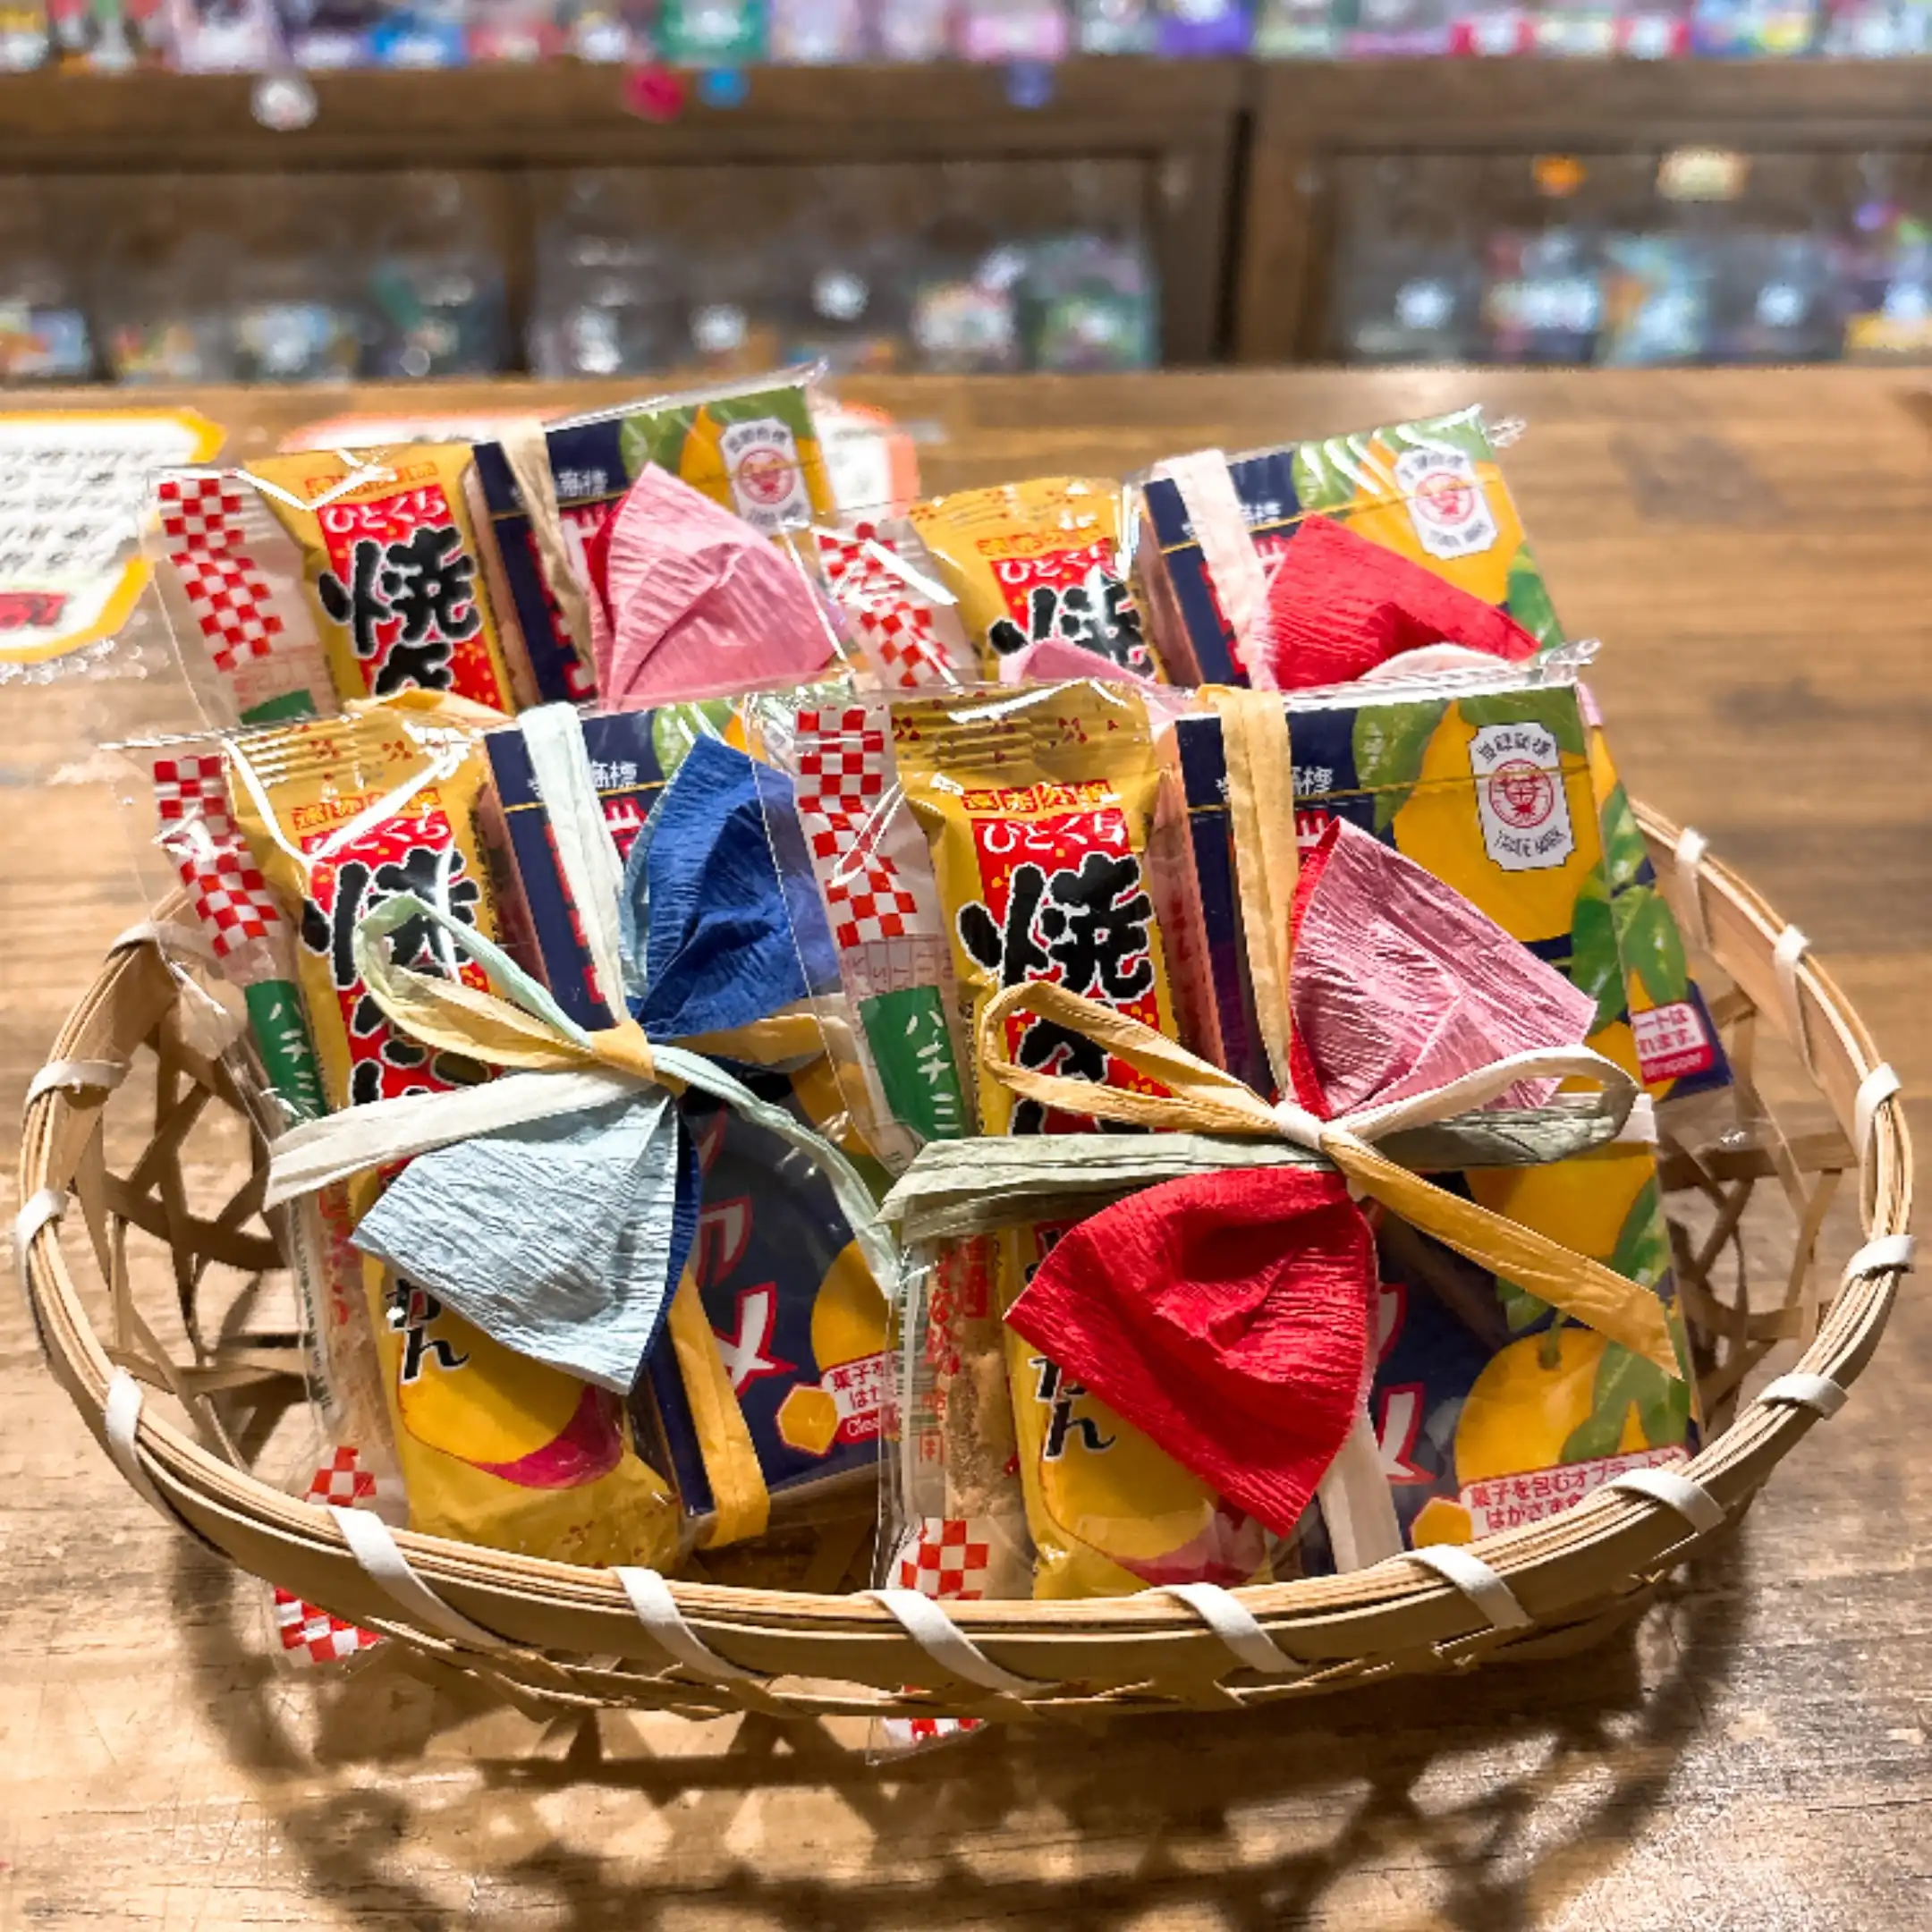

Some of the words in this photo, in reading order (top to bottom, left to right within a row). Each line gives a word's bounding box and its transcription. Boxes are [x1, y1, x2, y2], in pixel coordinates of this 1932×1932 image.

[325, 490, 446, 533] ひとくち
[983, 812, 1125, 854] ひとくち
